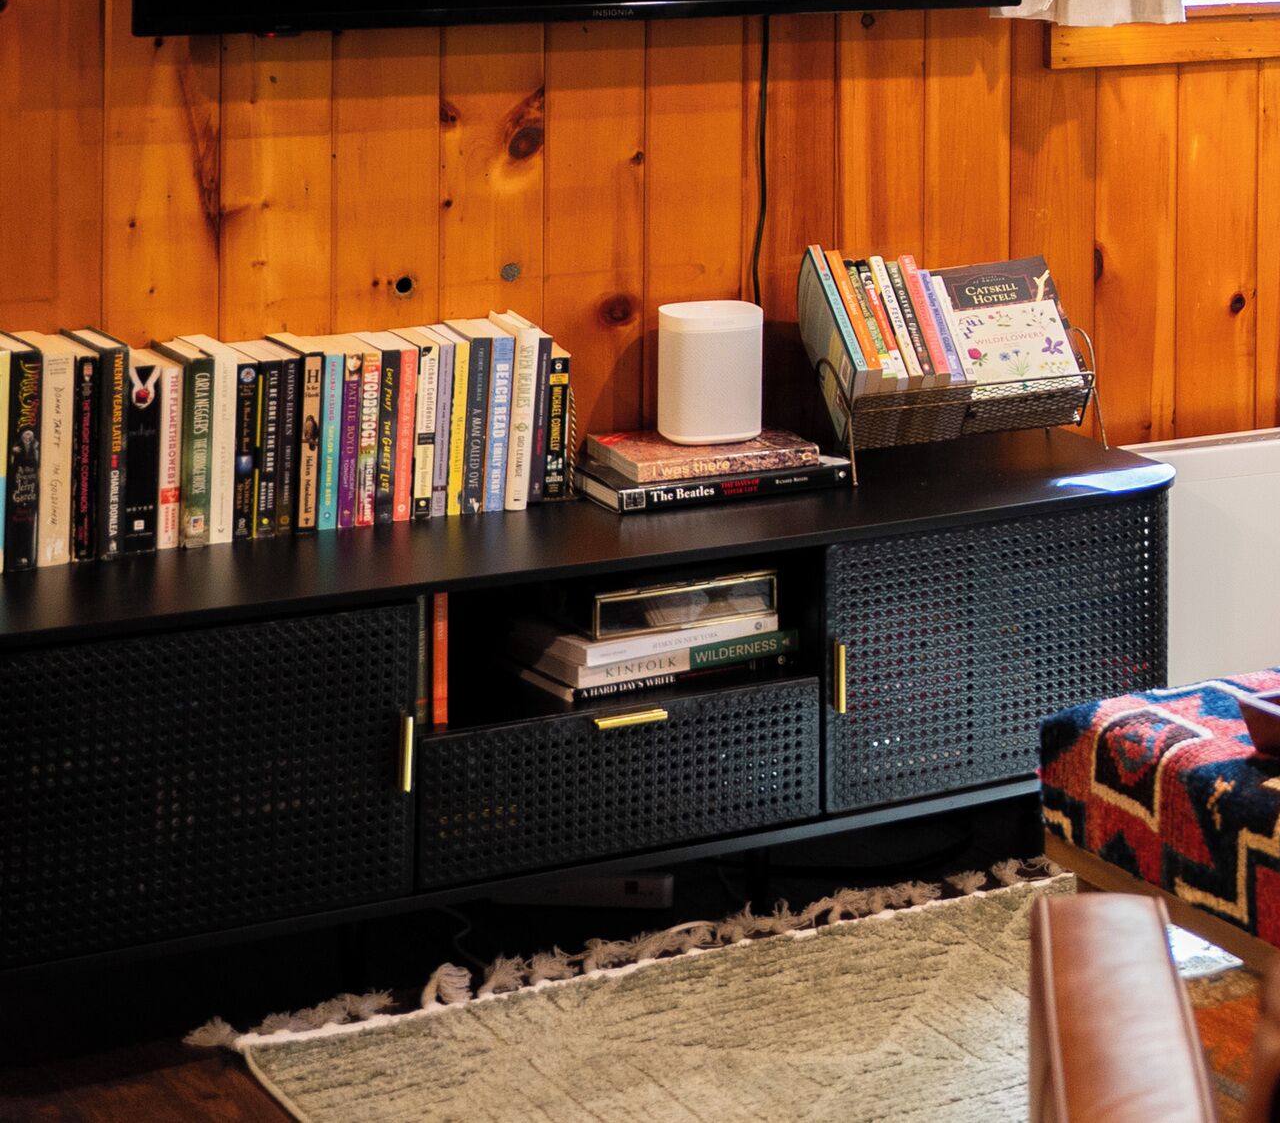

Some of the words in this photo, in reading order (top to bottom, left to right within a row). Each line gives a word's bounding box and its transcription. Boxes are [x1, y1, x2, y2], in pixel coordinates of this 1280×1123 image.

[892, 268, 900, 287] MARY
[899, 290, 912, 318] OLIVER
[965, 283, 1018, 296] CATSKILL
[973, 292, 1017, 304] HOTELS
[883, 285, 893, 303] ROAD
[891, 307, 903, 329] FEVER
[935, 308, 947, 336] WATERFALL
[975, 332, 1044, 345] WILDFLOWERS
[520, 345, 534, 369] SEVEN
[113, 353, 123, 391] TWENTY
[170, 375, 178, 393] THE
[194, 373, 210, 397] CARLA
[287, 363, 295, 400] STATION
[307, 369, 319, 384] H
[428, 358, 436, 386] Kitchen
[494, 363, 508, 403] BEACH
[54, 387, 65, 415] DONNA
[269, 388, 277, 397] BE
[476, 373, 484, 402] BACKMAN
[517, 373, 532, 408] DEADLIES
[552, 386, 562, 417] MICHAEL
[112, 394, 123, 422] YEARS
[193, 398, 210, 434] NEGGERS
[268, 401, 276, 420] GONE
[347, 384, 358, 422] PATTIE
[362, 371, 379, 446] WOODSTOCK
[425, 387, 434, 432] Confidential
[82, 413, 90, 444] TWILIGHT
[285, 403, 294, 436] ELEVEN
[454, 416, 463, 435] Mary
[471, 417, 480, 437] MAN
[492, 407, 506, 437] READ
[111, 424, 122, 452] LATER
[266, 435, 274, 448] THE
[346, 426, 356, 454] BOYD
[550, 419, 561, 451] CONNELLY
[81, 445, 89, 465] ZONE
[266, 452, 274, 472] DARK
[382, 437, 392, 471] GUEST
[469, 439, 479, 469] CALLED
[492, 443, 502, 467] EMILY
[515, 449, 524, 477] LEVANGIE
[661, 464, 689, 475] was
[694, 460, 730, 473] there
[80, 466, 89, 512] COMPANION
[110, 470, 119, 503] CHARLIE
[364, 458, 373, 494] MICHAEL
[380, 474, 390, 493] LIST
[468, 472, 478, 488] OVE
[491, 469, 501, 494] HENRY
[304, 479, 312, 514] Macdonald
[651, 490, 673, 502] The
[676, 486, 714, 499] Beatles
[109, 504, 118, 536] DONLEA
[363, 495, 372, 522] LANG
[604, 656, 677, 679] KINFOLK
[695, 639, 777, 663] WILDERNESS
[590, 684, 617, 696] HARD
[619, 680, 644, 693] DAY'S
[646, 675, 676, 688] WRITE
